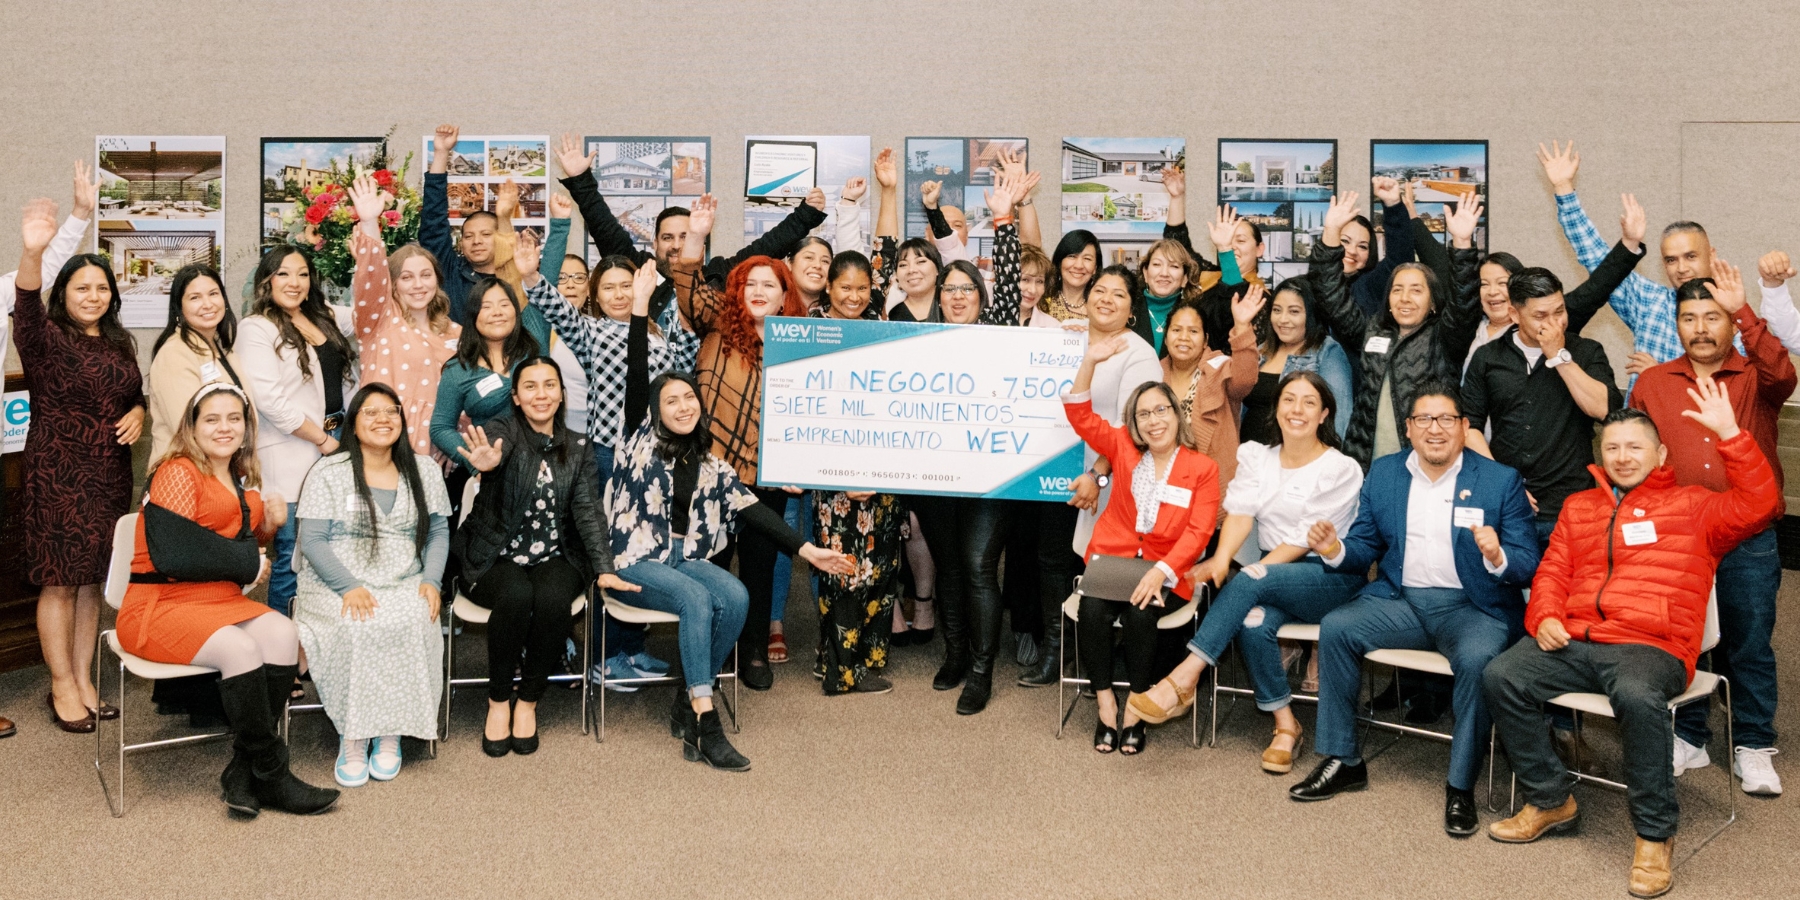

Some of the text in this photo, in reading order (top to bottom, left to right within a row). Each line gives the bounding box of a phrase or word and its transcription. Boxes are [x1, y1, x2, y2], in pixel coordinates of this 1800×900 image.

[771, 323, 811, 338] wev
[806, 370, 975, 395] MI NEGOCIO
[4, 398, 31, 425] e
[773, 396, 1014, 424] SIETE MIL QUINIENTOS
[784, 426, 1029, 454] EMPRENDIMIENTO WEV
